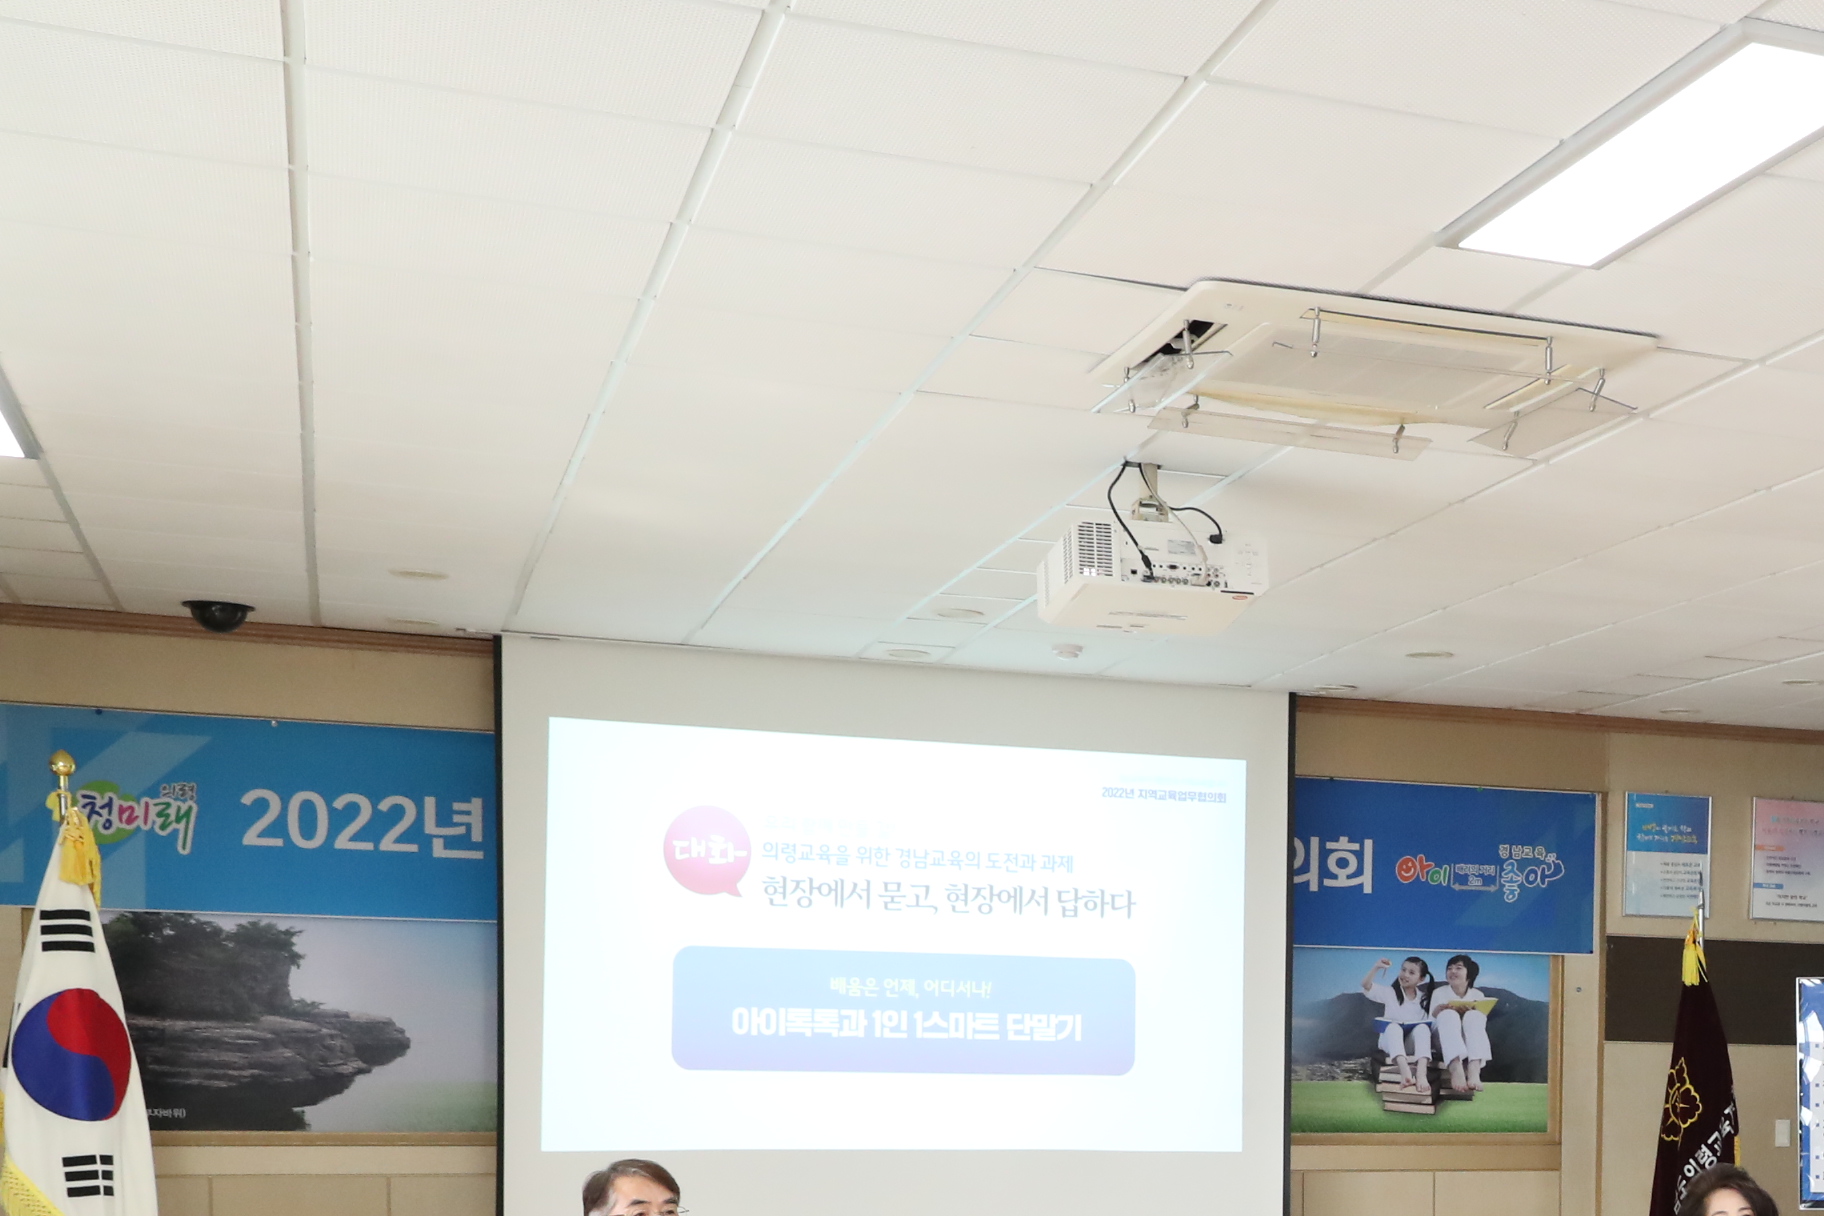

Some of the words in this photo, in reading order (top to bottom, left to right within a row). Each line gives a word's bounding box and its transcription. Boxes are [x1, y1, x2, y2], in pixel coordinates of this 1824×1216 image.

[1102, 787, 1135, 799] 2022년
[241, 788, 485, 859] 2022년
[672, 833, 749, 865] 대화
[762, 841, 851, 866] 의령교육을
[856, 845, 890, 868] 위한
[895, 847, 981, 871] 경남교육의
[985, 851, 1036, 872] 도전과
[1039, 853, 1075, 874] 과제
[1498, 844, 1546, 859] 경남교육
[1396, 854, 1449, 886] 아이
[1467, 875, 1483, 886] 2m
[762, 875, 871, 909] 현장에서
[878, 879, 938, 916] 묻고,
[944, 883, 1050, 916] 현장에서
[1056, 887, 1137, 920] 답하다
[829, 975, 880, 998] 배움은
[882, 976, 920, 1000] 언제,
[923, 978, 993, 1000] 어디서나!
[732, 1006, 867, 1039] 아이톡톡과
[871, 1009, 909, 1039] 1인
[913, 1009, 1000, 1042] 1스마트
[1006, 1011, 1082, 1044] 단말기
